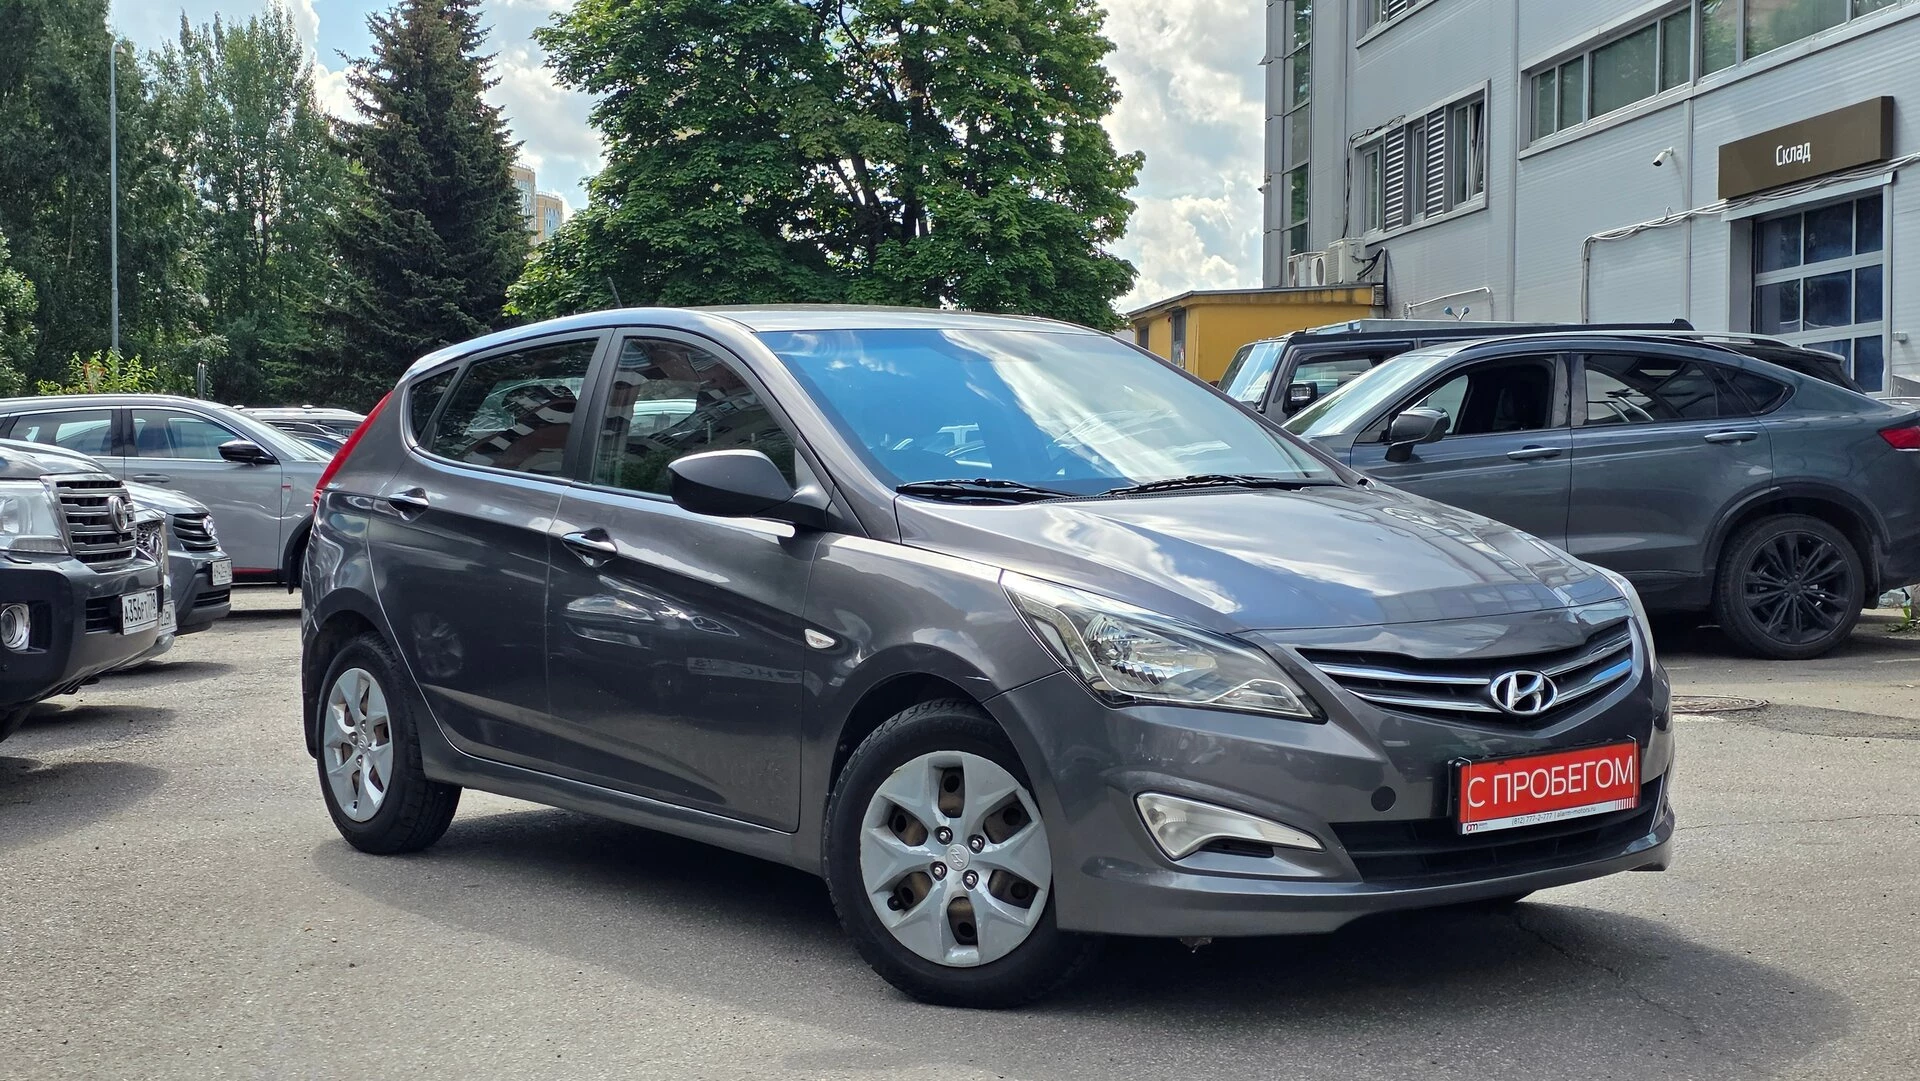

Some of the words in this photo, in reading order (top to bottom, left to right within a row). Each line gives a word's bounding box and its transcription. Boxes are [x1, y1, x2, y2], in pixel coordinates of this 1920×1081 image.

[1775, 142, 1811, 166] Склад
[1467, 776, 1486, 808] С
[1493, 755, 1634, 805] ПРОБЕГОМ
